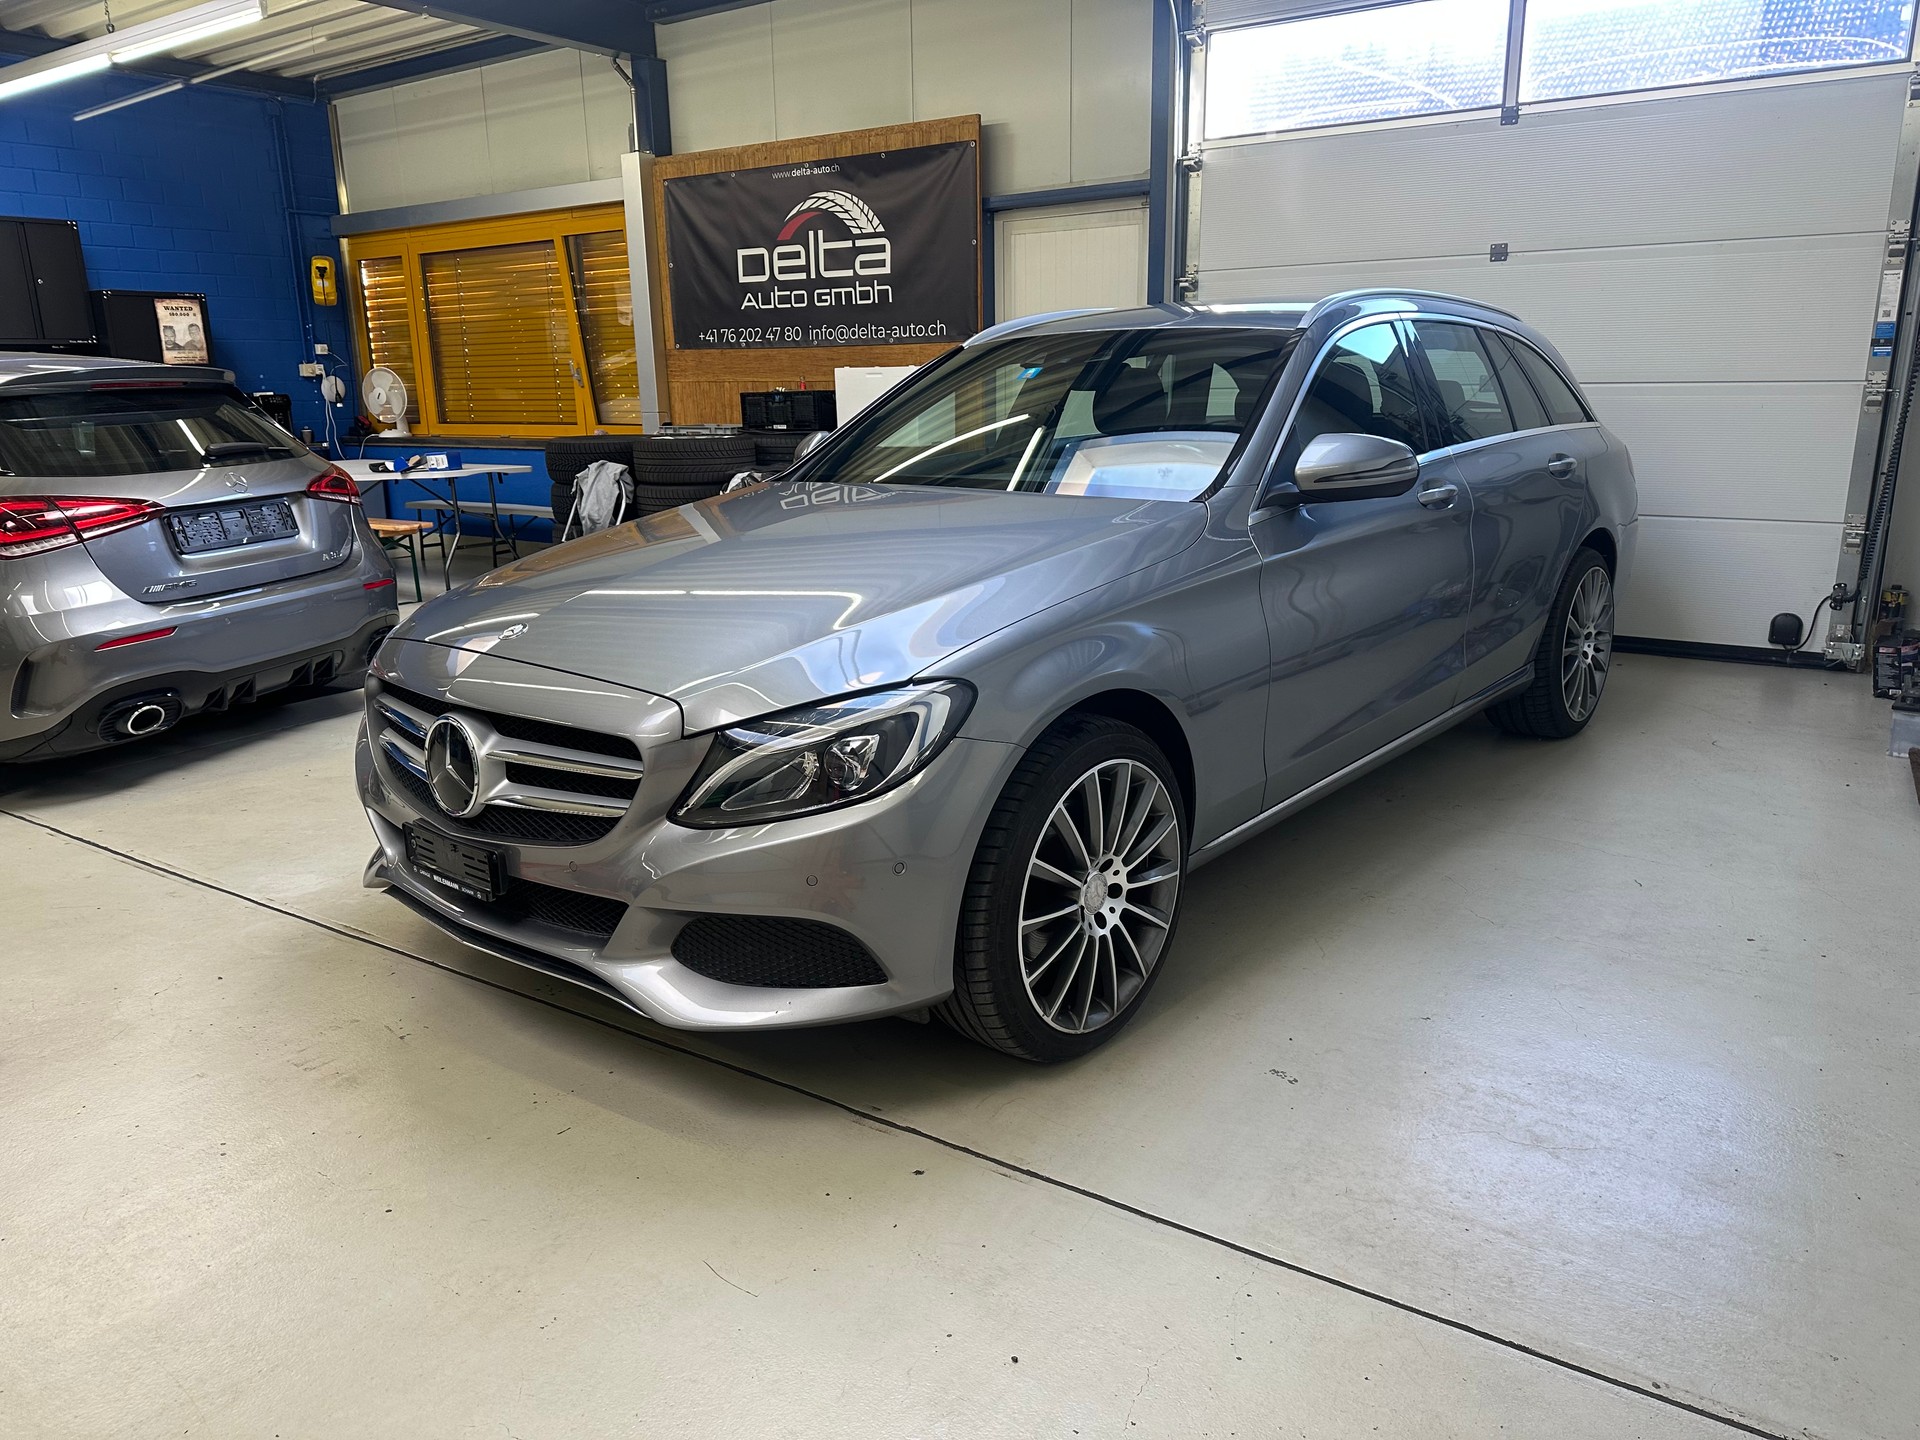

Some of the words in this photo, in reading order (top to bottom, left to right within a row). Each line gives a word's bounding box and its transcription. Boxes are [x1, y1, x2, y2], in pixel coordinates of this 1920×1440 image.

[741, 285, 808, 310] Auto
[699, 328, 718, 343] +41
[720, 328, 737, 343] 76
[738, 327, 763, 342] 202
[765, 326, 781, 342] 47
[784, 326, 802, 341] 80
[808, 319, 947, 343] info@delta-auto.ch
